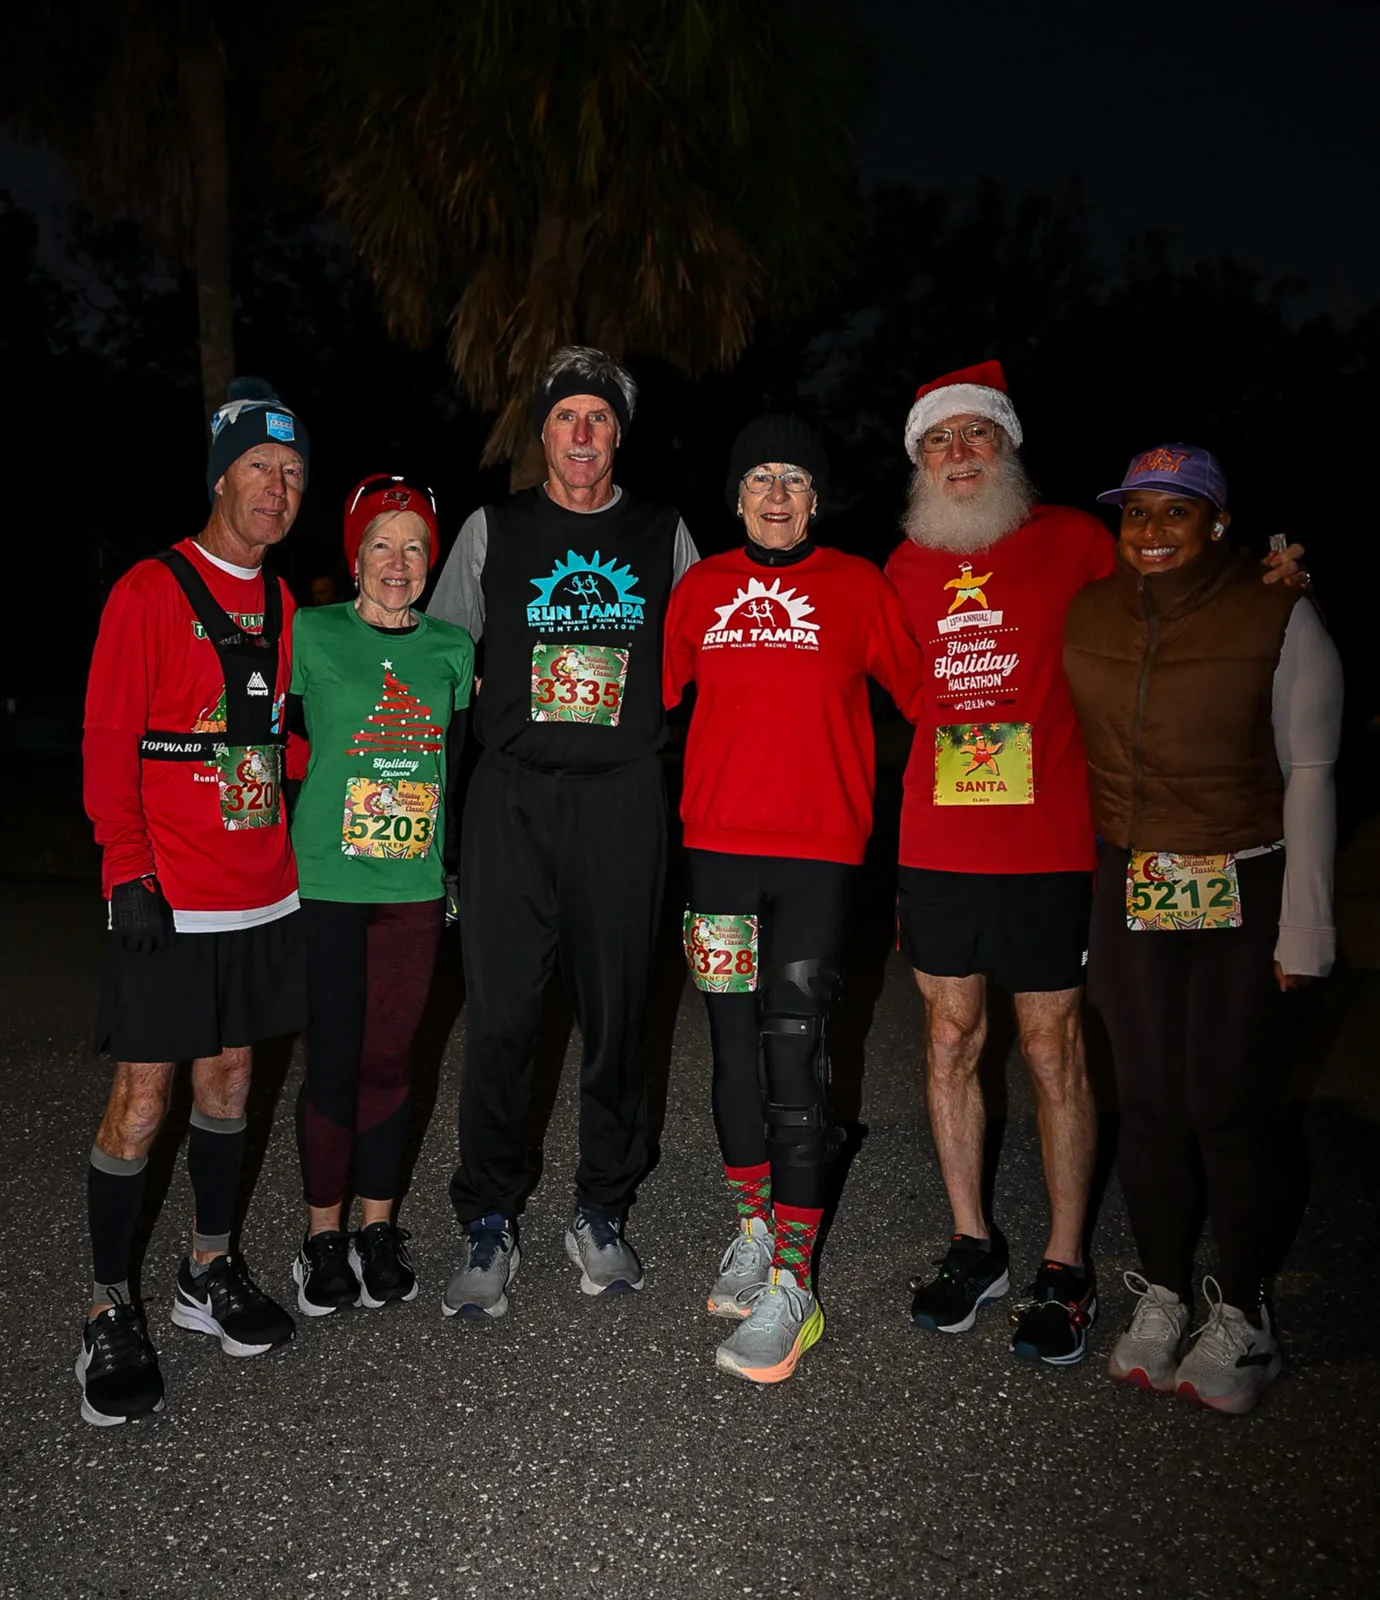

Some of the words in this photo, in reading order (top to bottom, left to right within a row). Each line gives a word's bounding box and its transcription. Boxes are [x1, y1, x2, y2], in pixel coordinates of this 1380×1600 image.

[527, 605, 571, 621] RUN
[578, 604, 644, 620] TAMPA
[963, 613, 989, 623] ANNUAL
[540, 624, 636, 633] RUNTAMPA.COM
[703, 629, 744, 645] RUN
[749, 628, 819, 645] TAMPA
[947, 638, 997, 657] Florida
[934, 652, 1020, 680] Holiday
[948, 674, 1002, 692] HALFATHON
[537, 678, 620, 708] 3335
[141, 740, 202, 753] TOPWARD
[373, 758, 420, 772] Holiday
[956, 781, 1008, 793] SANTA
[349, 814, 430, 842] 5203
[1132, 878, 1234, 911] 5212
